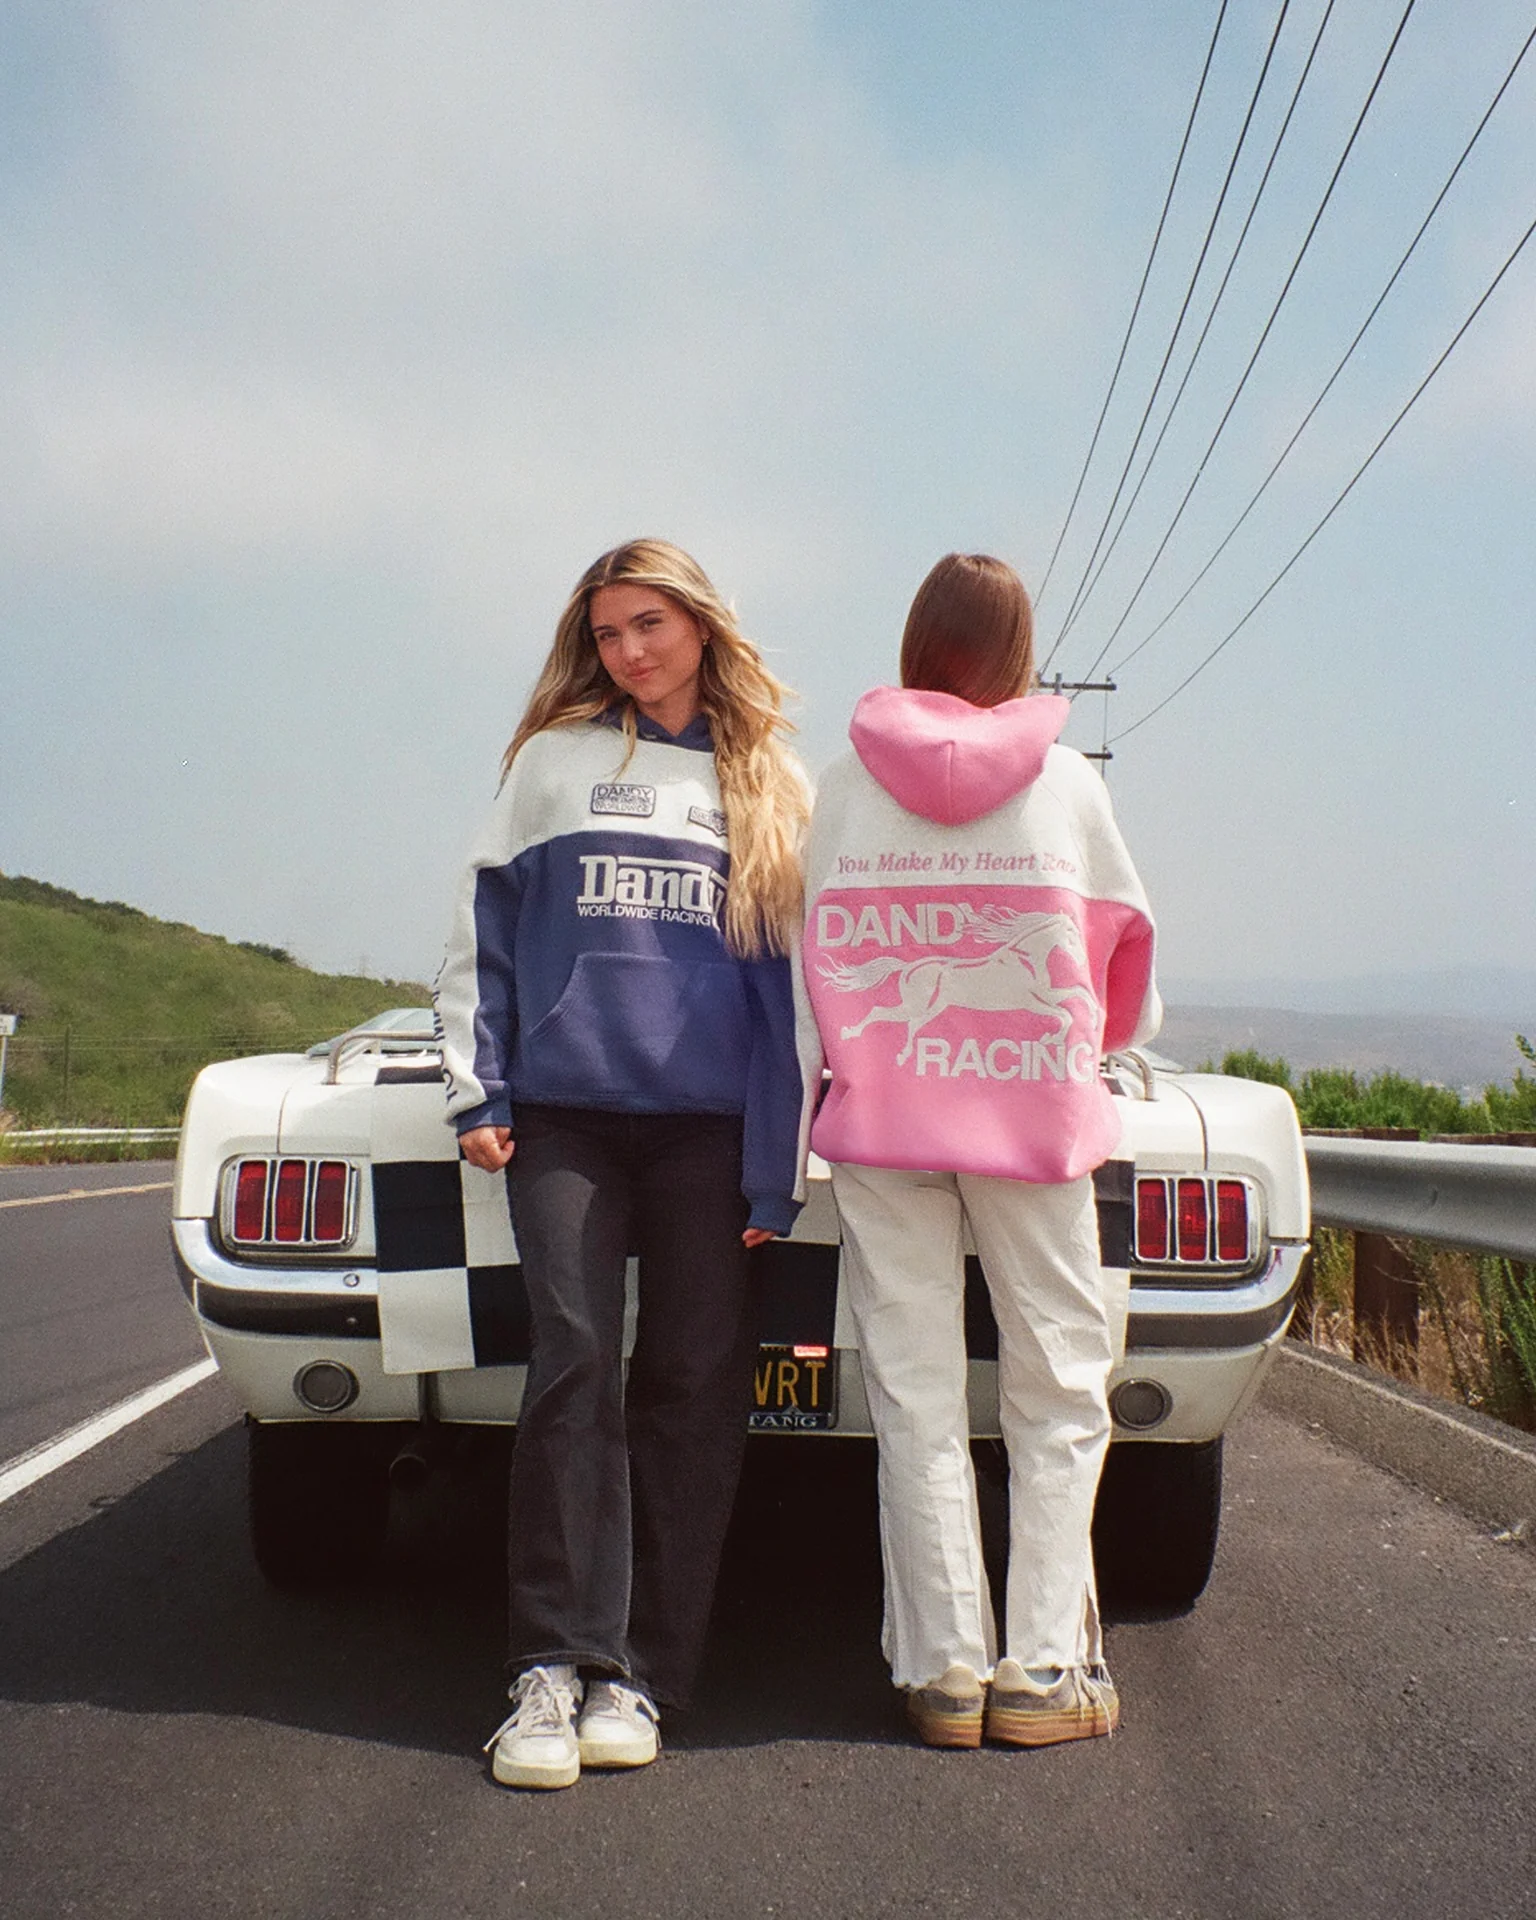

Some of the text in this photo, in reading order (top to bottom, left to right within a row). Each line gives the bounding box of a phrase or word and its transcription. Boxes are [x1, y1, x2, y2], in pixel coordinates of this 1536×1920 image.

[597, 786, 652, 799] DANDY
[837, 855, 870, 875] You
[875, 852, 933, 872] Make
[938, 853, 969, 875] My
[974, 853, 1036, 872] Heart
[577, 904, 713, 927] WORLDWIDE RACING
[915, 1037, 1094, 1083] RACING
[755, 1360, 826, 1407] VRT
[749, 1415, 817, 1428] TANG
